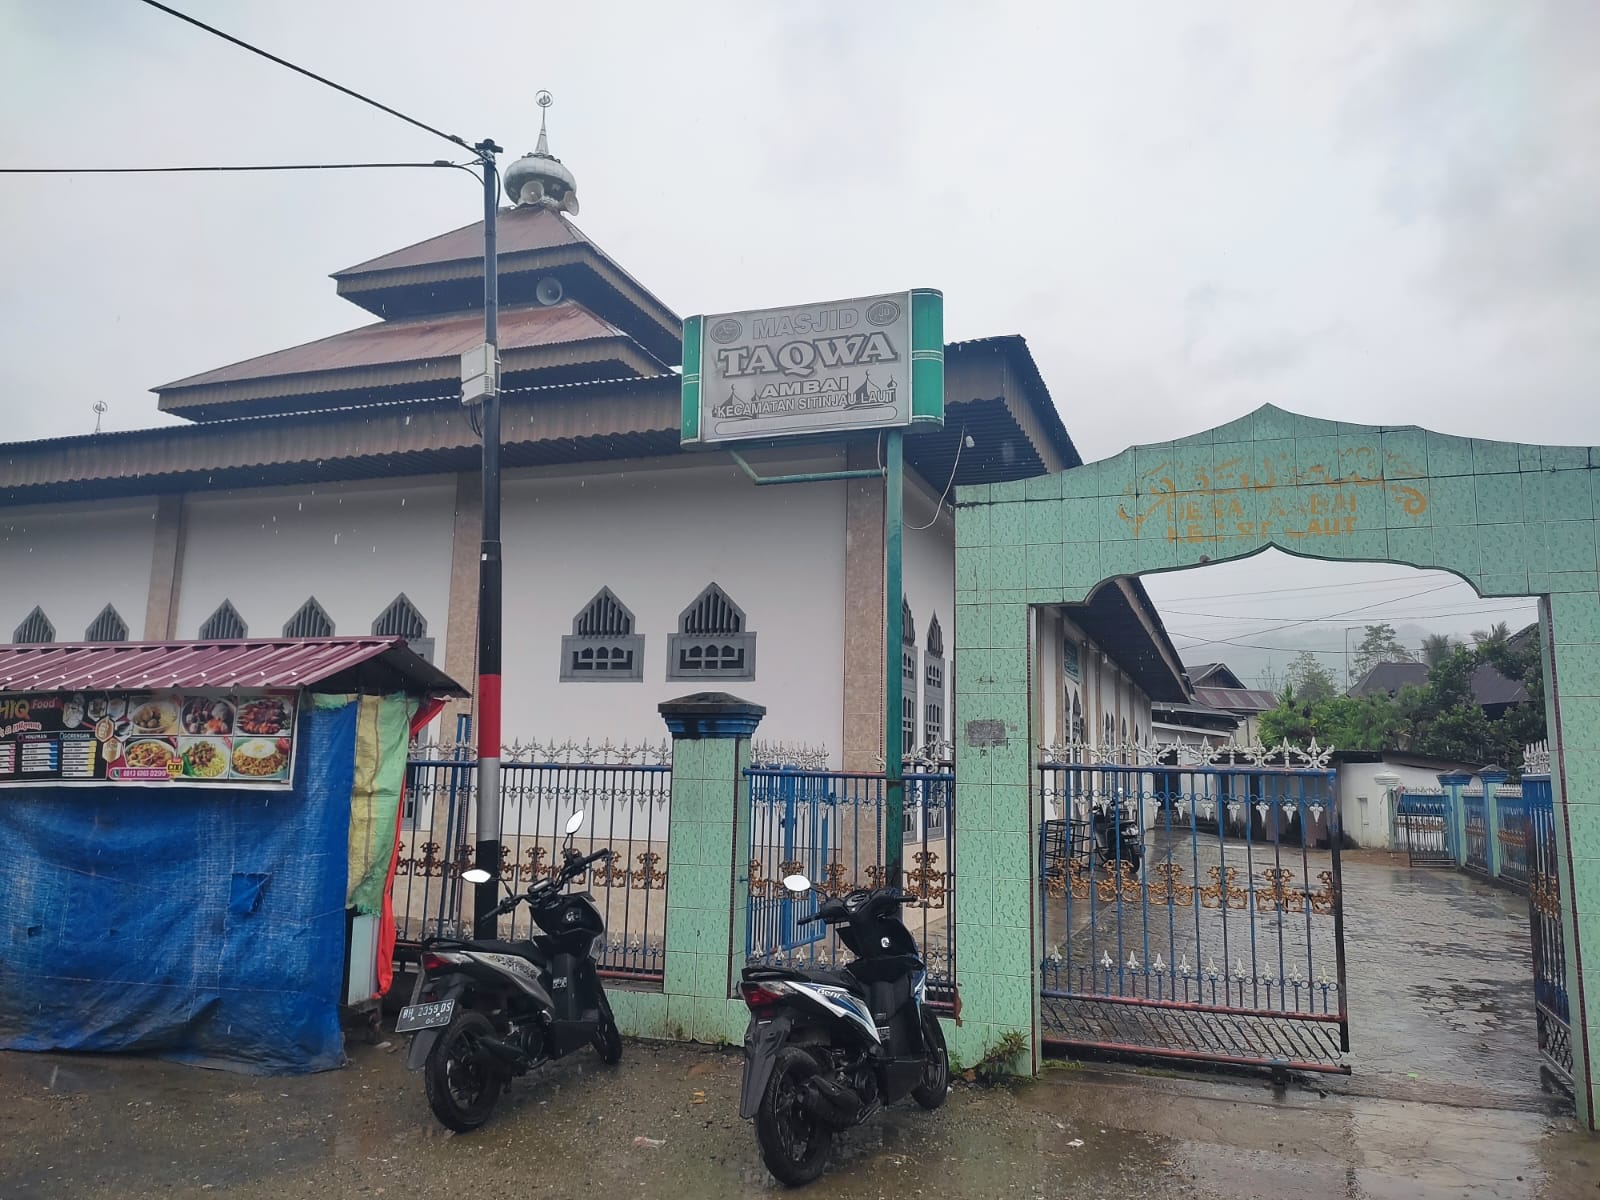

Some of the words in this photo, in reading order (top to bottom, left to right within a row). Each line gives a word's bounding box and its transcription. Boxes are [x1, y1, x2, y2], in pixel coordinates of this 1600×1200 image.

[753, 308, 859, 340] MASJID
[718, 331, 898, 379] TAQWA
[760, 376, 849, 399] AMBAI
[716, 399, 796, 418] KECAMATAN
[798, 392, 857, 411] SITINJAU
[861, 389, 895, 405] LAUT
[32, 698, 57, 710] Food
[418, 1003, 439, 1017] 2359
[440, 1002, 451, 1013] DS
